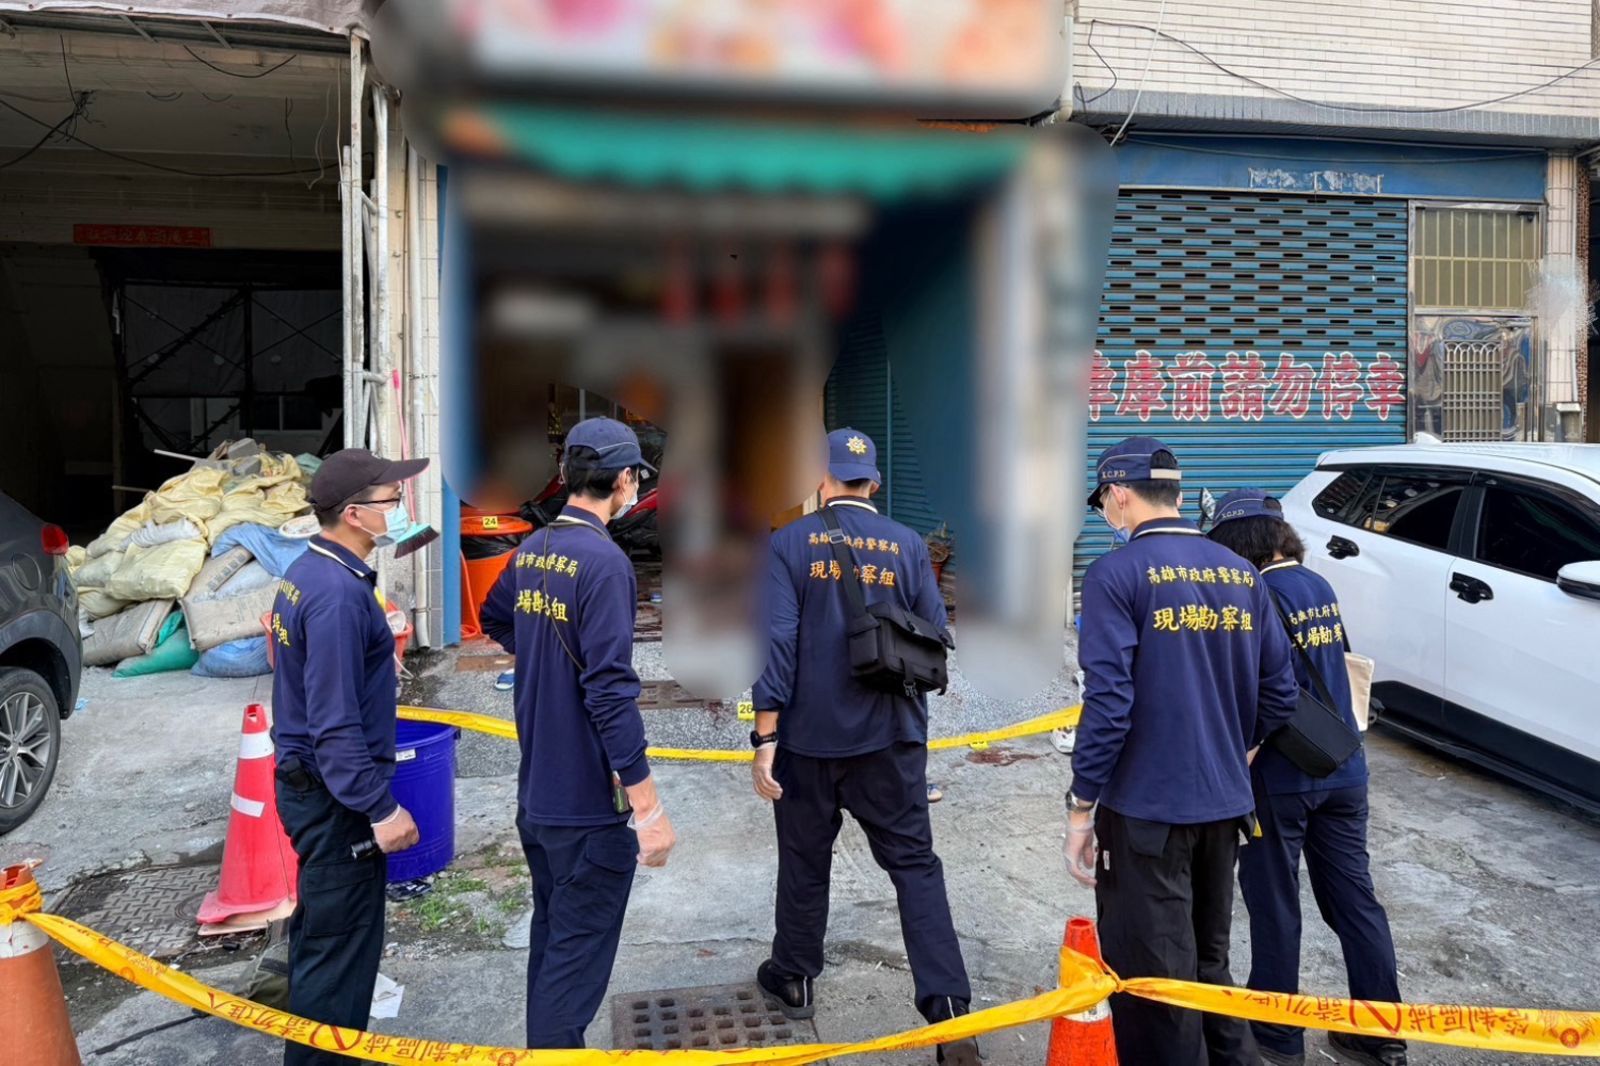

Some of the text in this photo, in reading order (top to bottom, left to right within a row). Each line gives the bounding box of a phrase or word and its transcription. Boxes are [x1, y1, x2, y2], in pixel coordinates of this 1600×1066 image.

[484, 517, 497, 526] 24
[809, 560, 895, 586] 現場察組
[1147, 565, 1254, 588] 高雄市政府警察局
[1153, 604, 1253, 631] 現場勘察組
